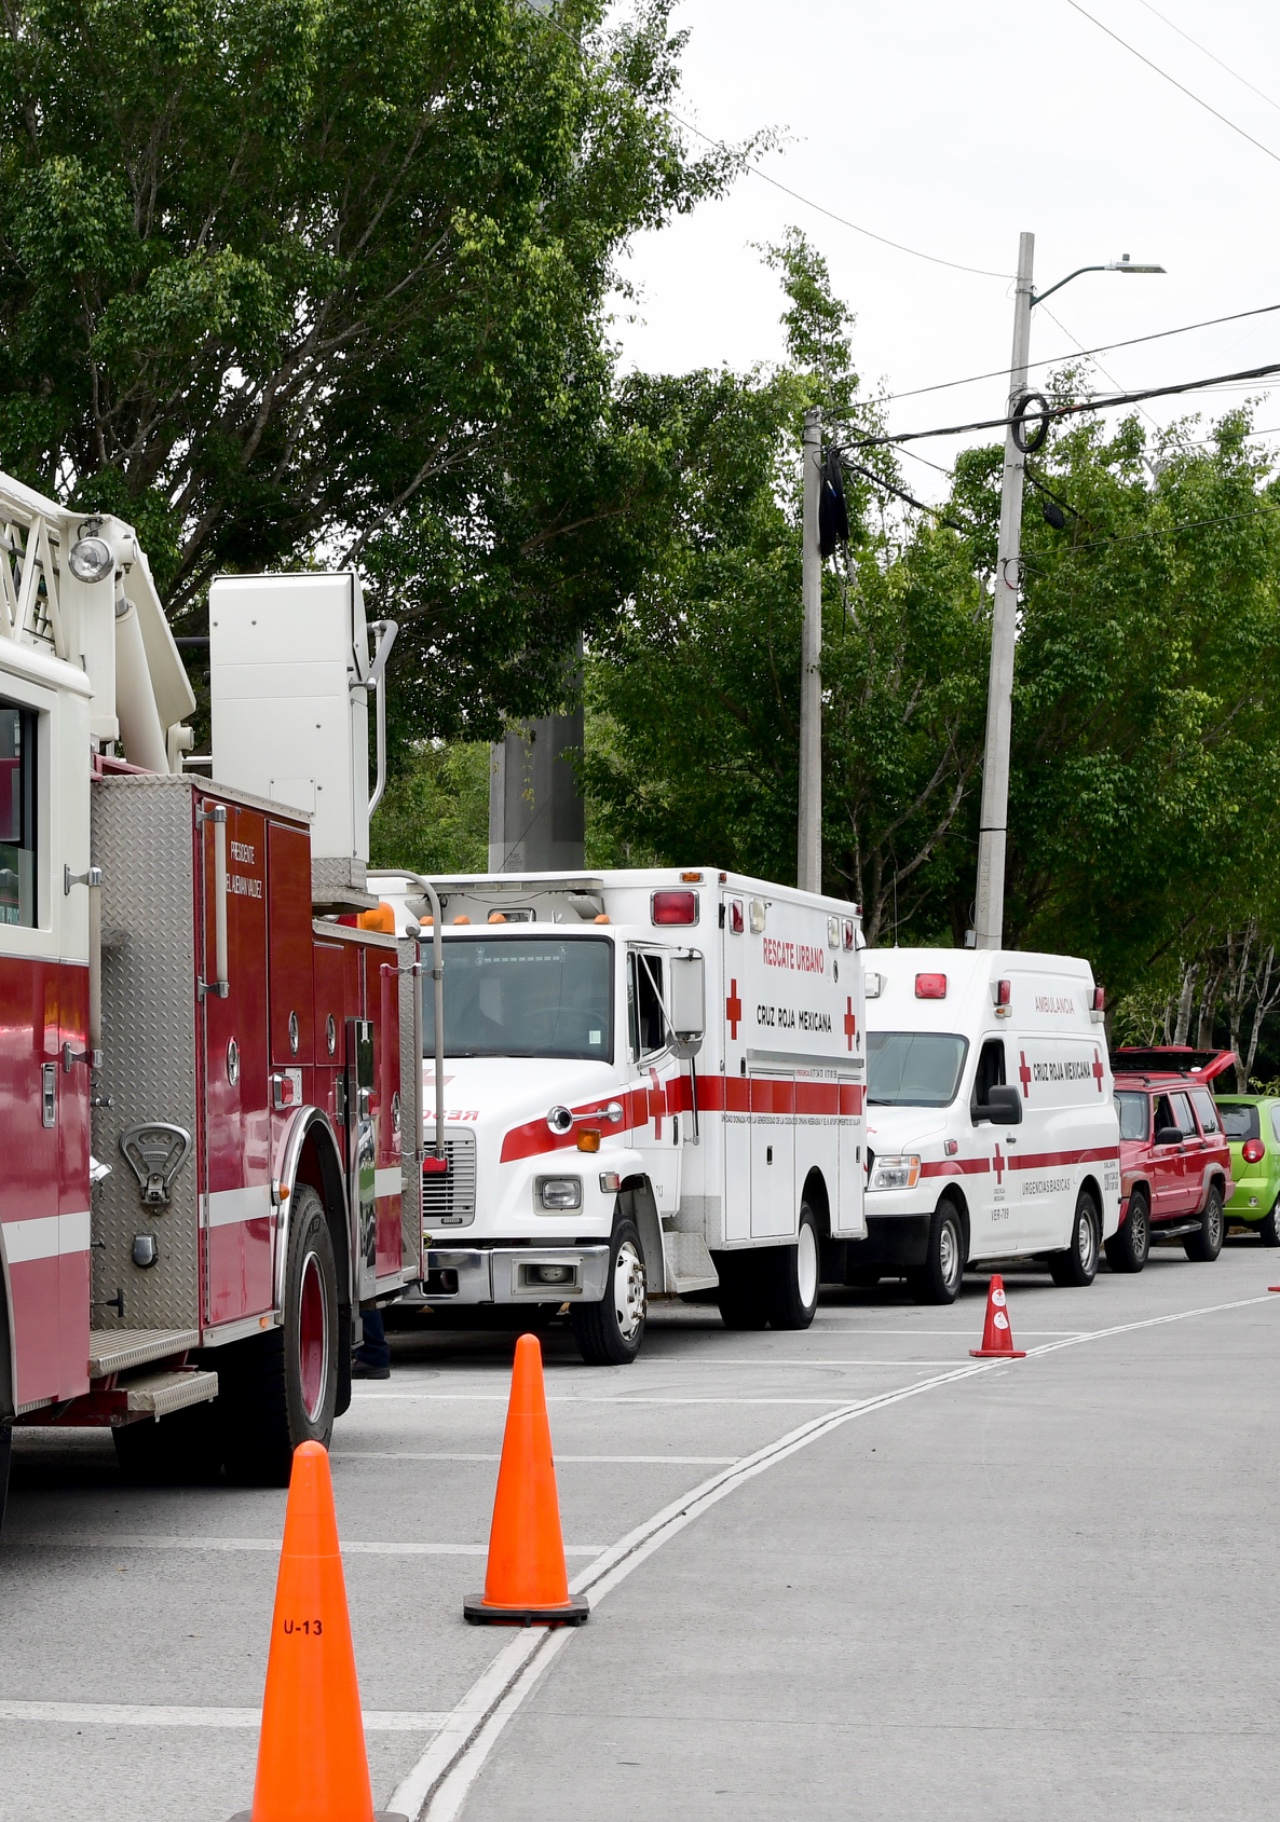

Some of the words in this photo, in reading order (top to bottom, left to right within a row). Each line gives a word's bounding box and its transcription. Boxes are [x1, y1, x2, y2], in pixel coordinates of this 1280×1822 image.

[763, 937, 795, 970] RESCATE
[795, 944, 825, 974] URBANO
[1035, 996, 1075, 1014] AMBULANCIA
[756, 1004, 775, 1027] CRUZ
[778, 1007, 796, 1029] ROJA
[799, 1010, 832, 1033] MEXICANA
[1033, 1062, 1049, 1081] CRUZ
[1049, 1062, 1064, 1080] ROJA
[1064, 1061, 1091, 1080] MEXICANA
[1022, 1180, 1050, 1195] URGENCIAS
[1050, 1178, 1070, 1192] BASICAS
[284, 1619, 323, 1636] U-13
